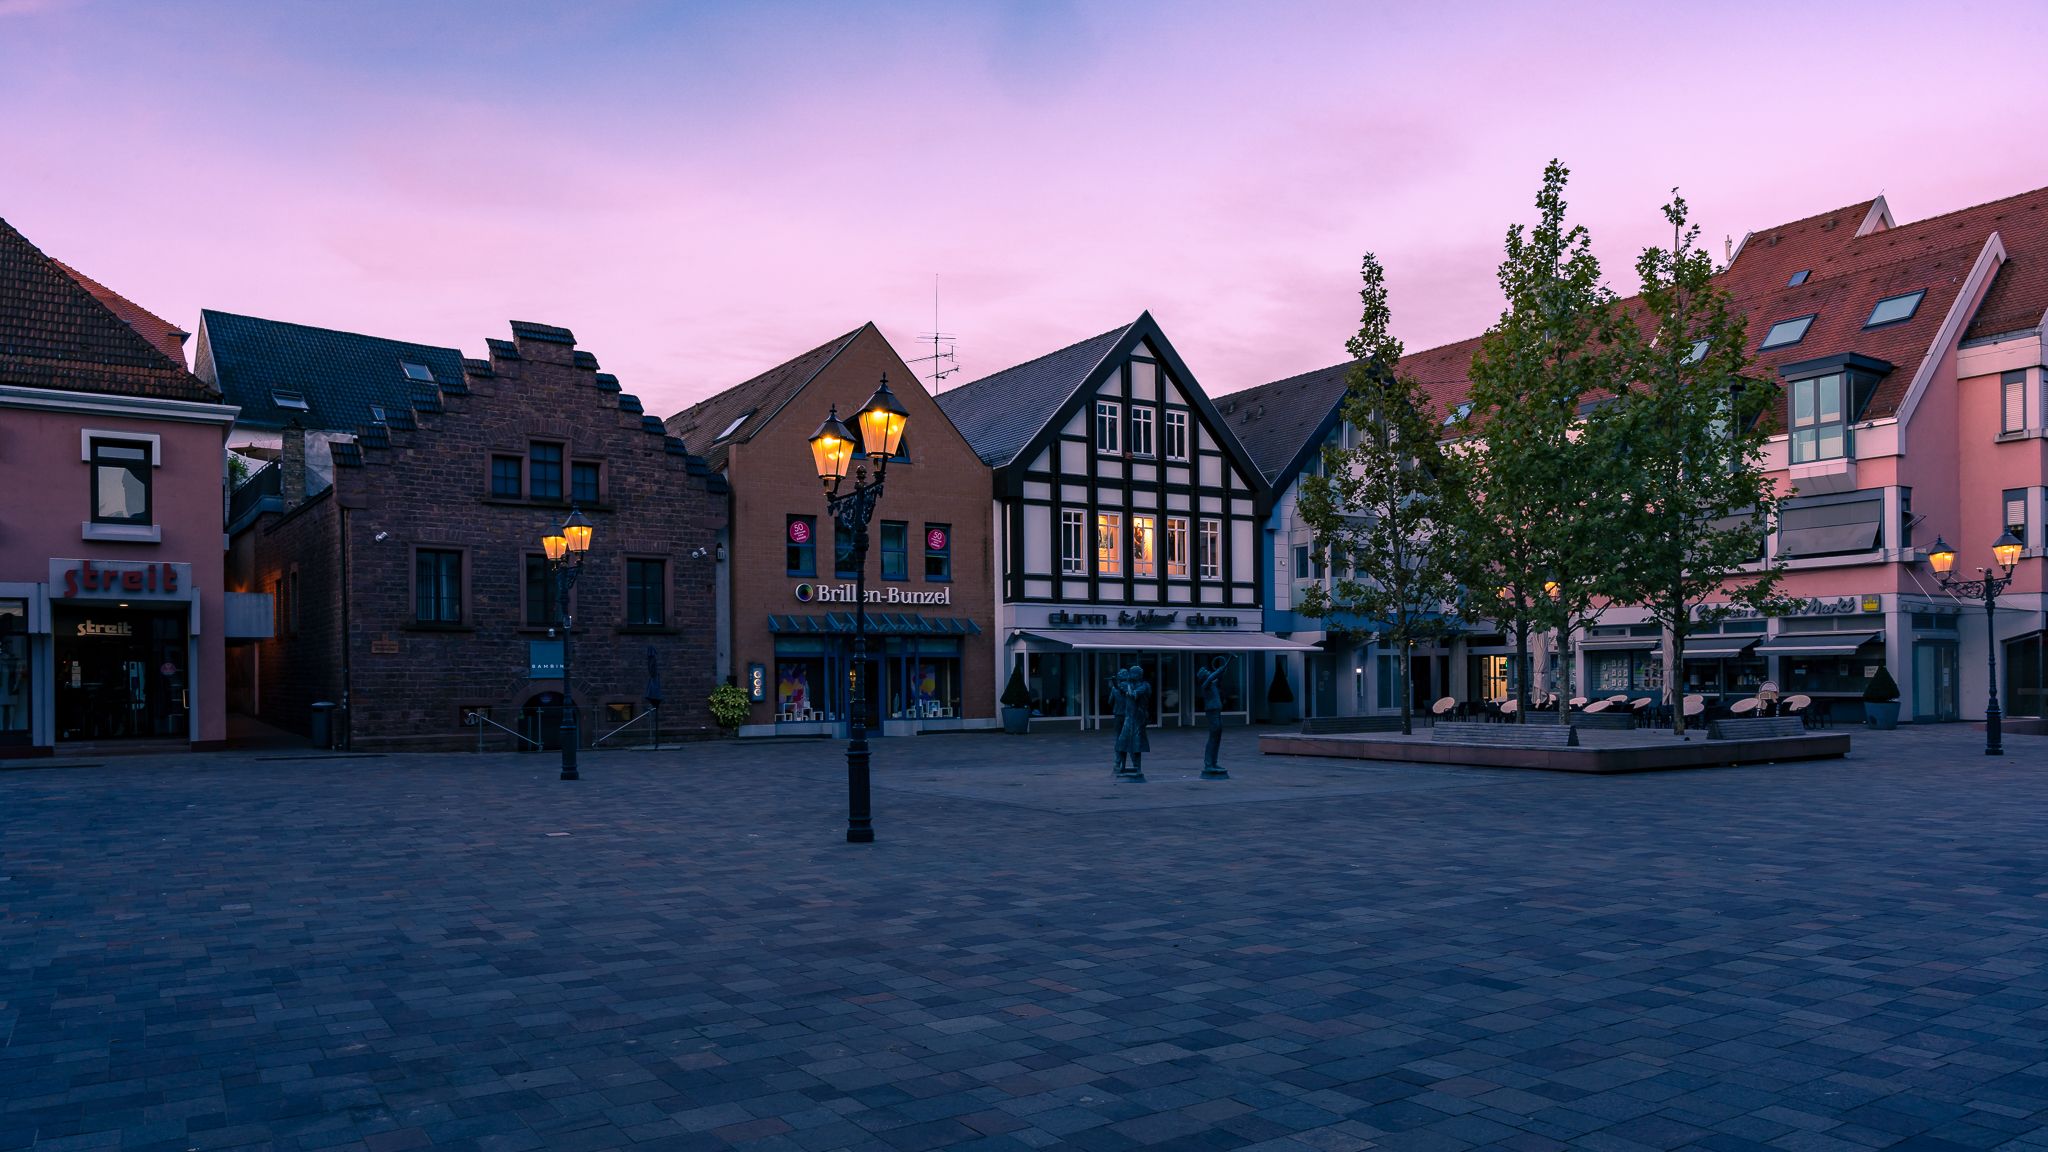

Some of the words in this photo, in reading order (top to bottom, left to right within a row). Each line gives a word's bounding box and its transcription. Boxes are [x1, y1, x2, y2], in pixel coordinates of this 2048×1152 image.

[793, 523, 804, 532] 50
[933, 531, 943, 540] 50
[64, 560, 178, 598] streit
[816, 584, 951, 605] Brillen-Bunzel
[1801, 597, 1855, 615] Markt
[1049, 610, 1107, 624] durm
[1186, 612, 1238, 626] durm
[76, 619, 133, 636] streit
